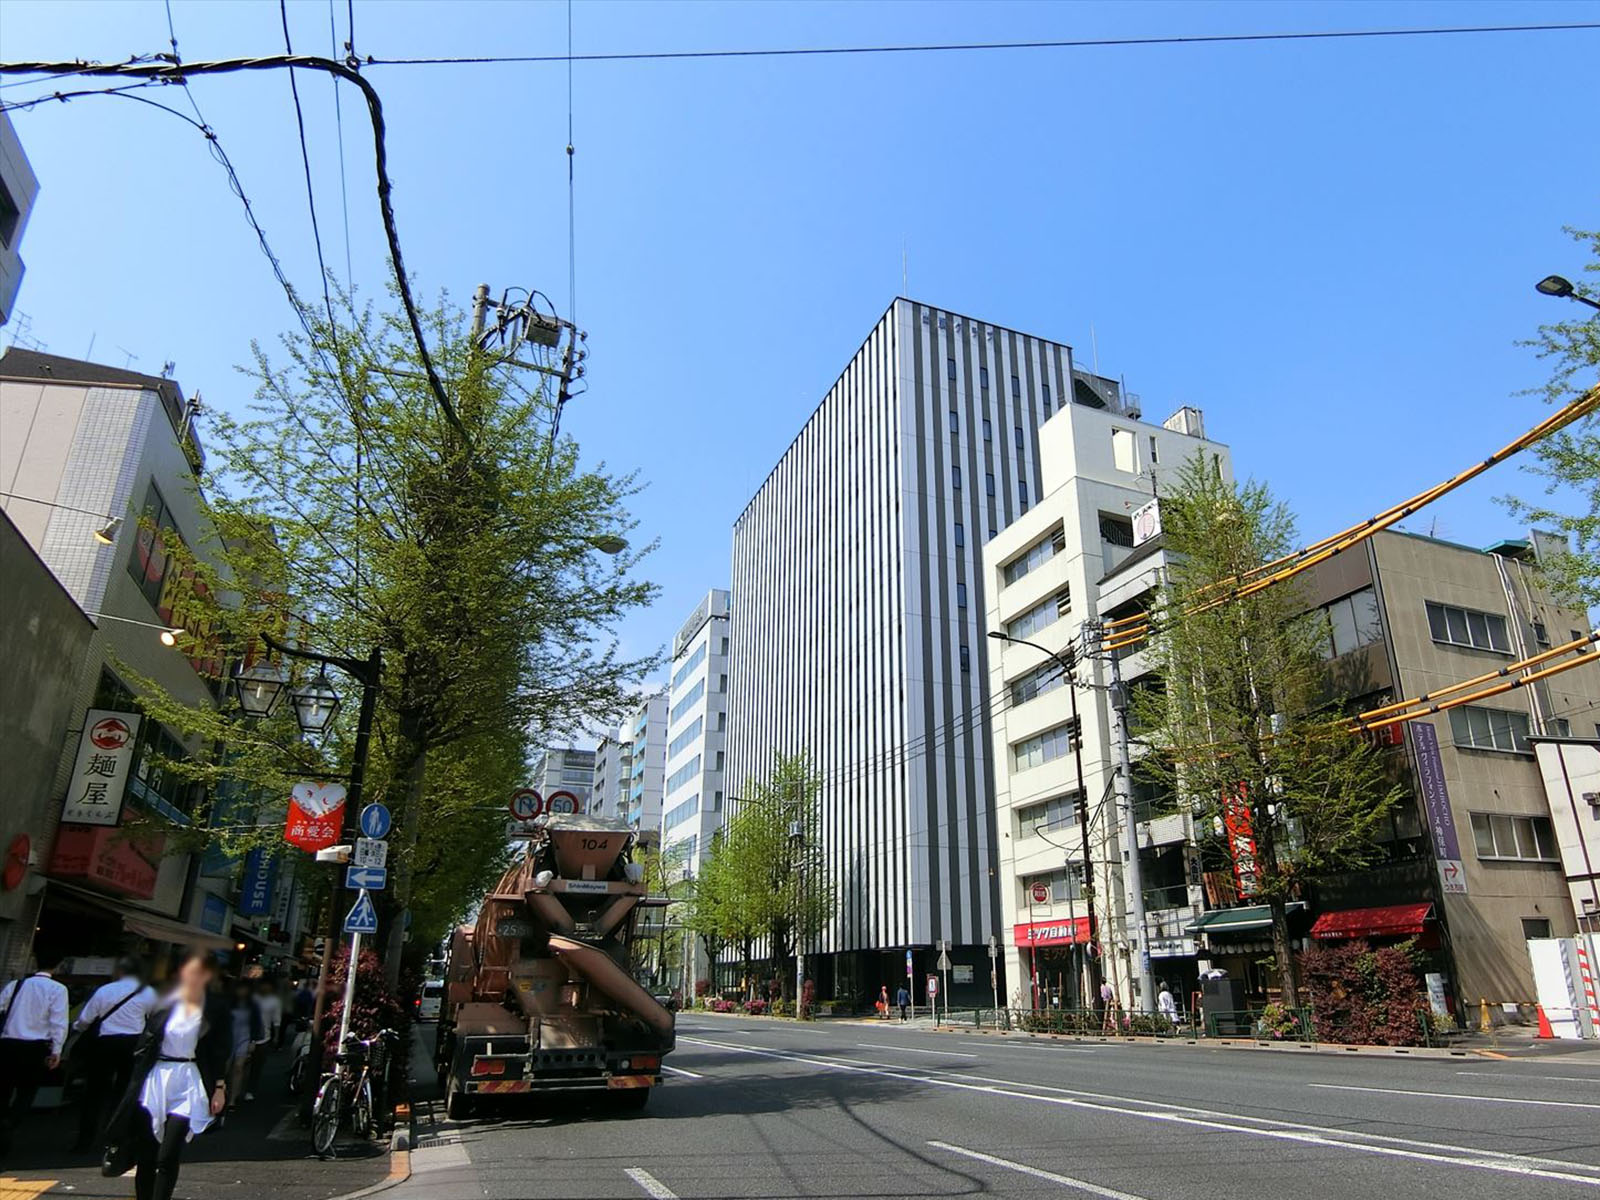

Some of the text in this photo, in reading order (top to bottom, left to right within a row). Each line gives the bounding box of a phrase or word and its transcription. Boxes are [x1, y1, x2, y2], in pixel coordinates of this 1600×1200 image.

[76, 753, 117, 805] 麺屋
[552, 799, 571, 814] 50
[581, 838, 608, 850] 104
